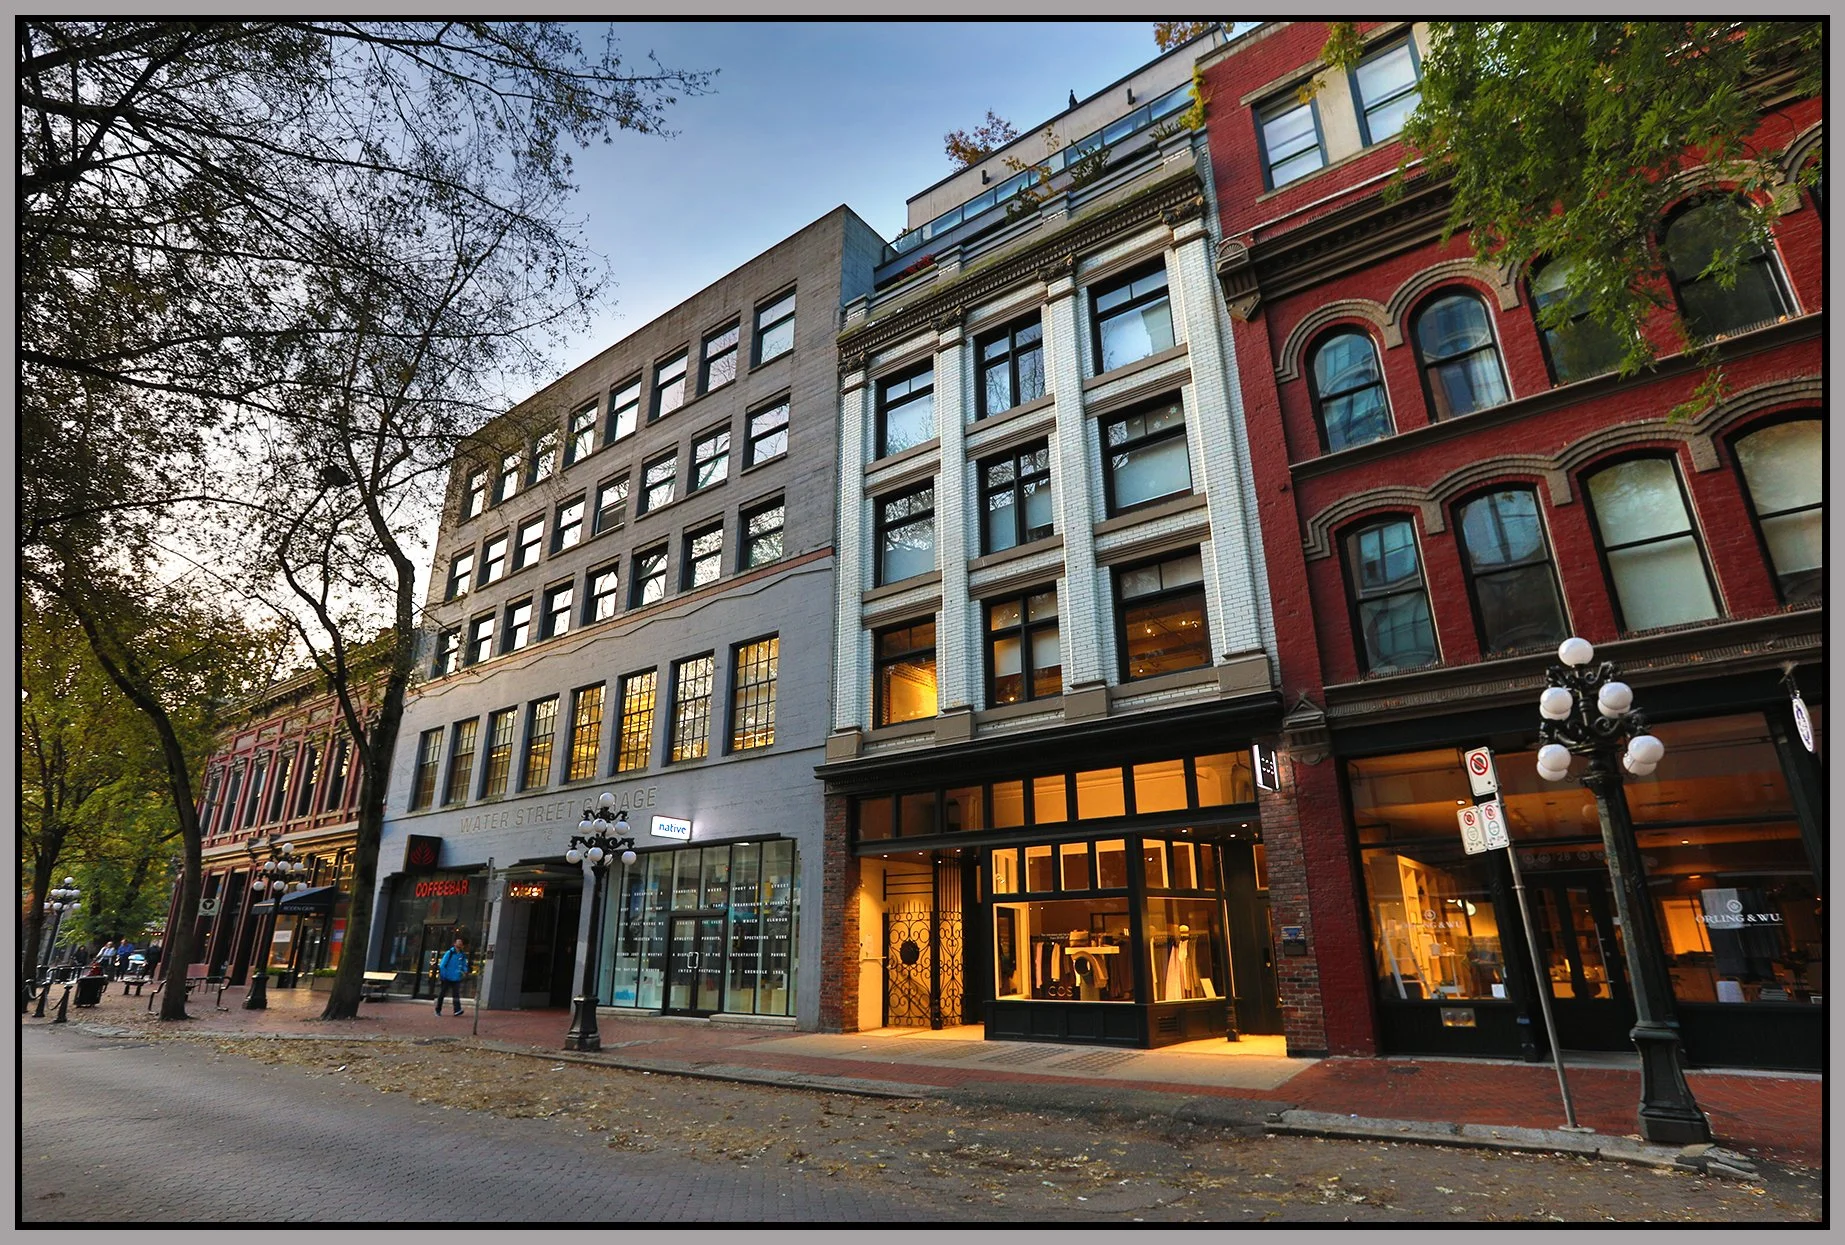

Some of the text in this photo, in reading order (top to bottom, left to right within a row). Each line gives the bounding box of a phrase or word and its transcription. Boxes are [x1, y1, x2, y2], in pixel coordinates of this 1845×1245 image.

[460, 787, 658, 834] WATER STREET GAGE
[659, 823, 687, 835] native
[415, 879, 470, 898] COFFEEBAR
[1047, 985, 1073, 997] COS
